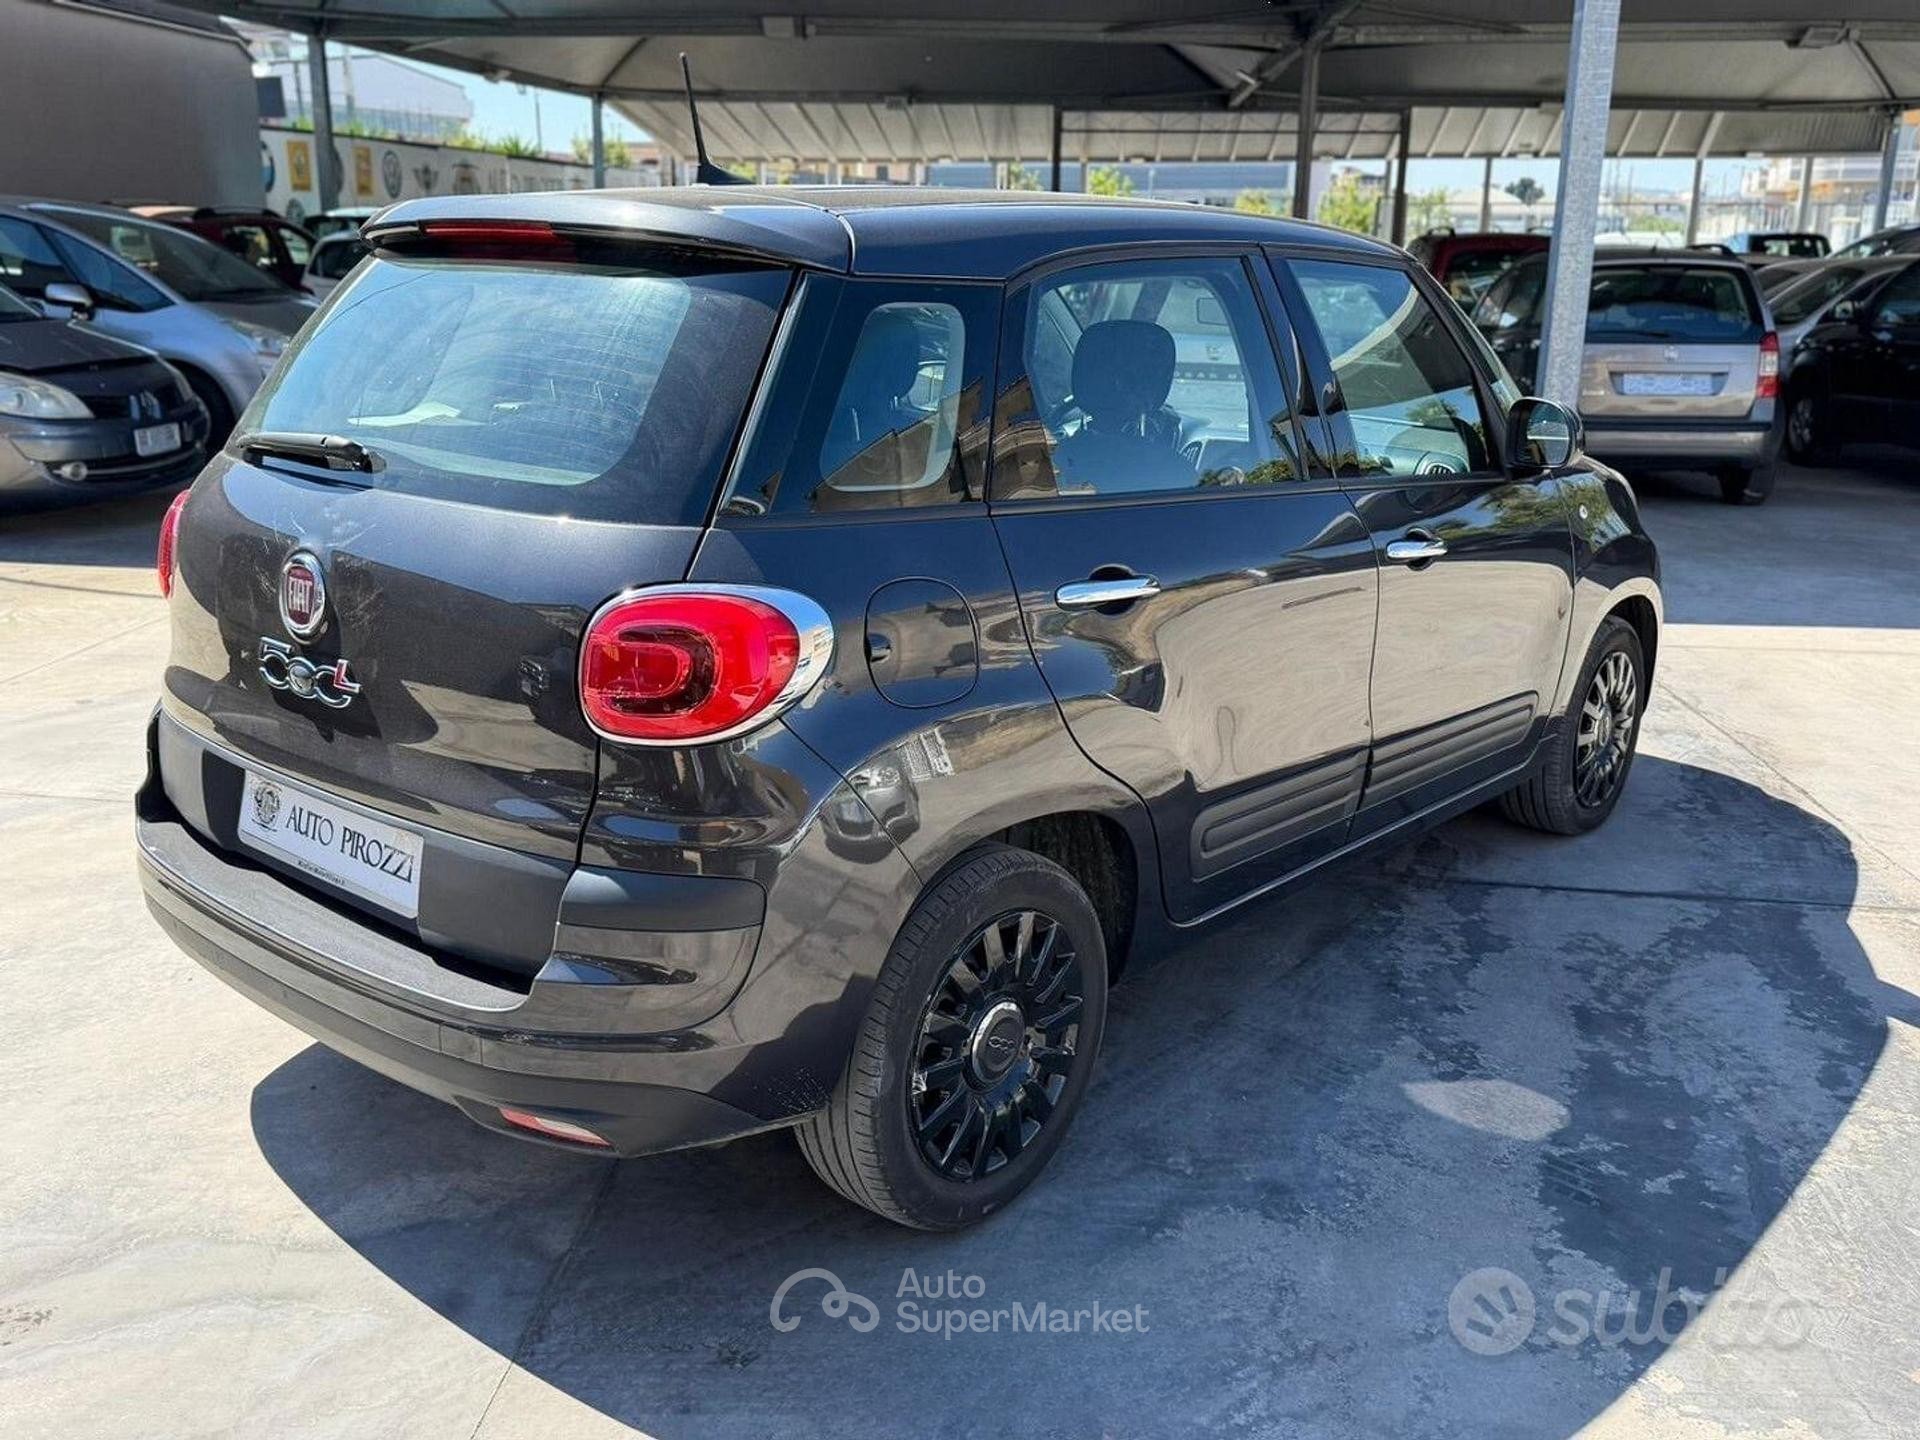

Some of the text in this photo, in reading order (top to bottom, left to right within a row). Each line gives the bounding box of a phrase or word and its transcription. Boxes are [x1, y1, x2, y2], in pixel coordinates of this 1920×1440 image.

[288, 576, 313, 614] FIAT
[259, 636, 362, 708] 500L
[286, 805, 335, 846] AUTO
[340, 825, 415, 884] PIROZZI
